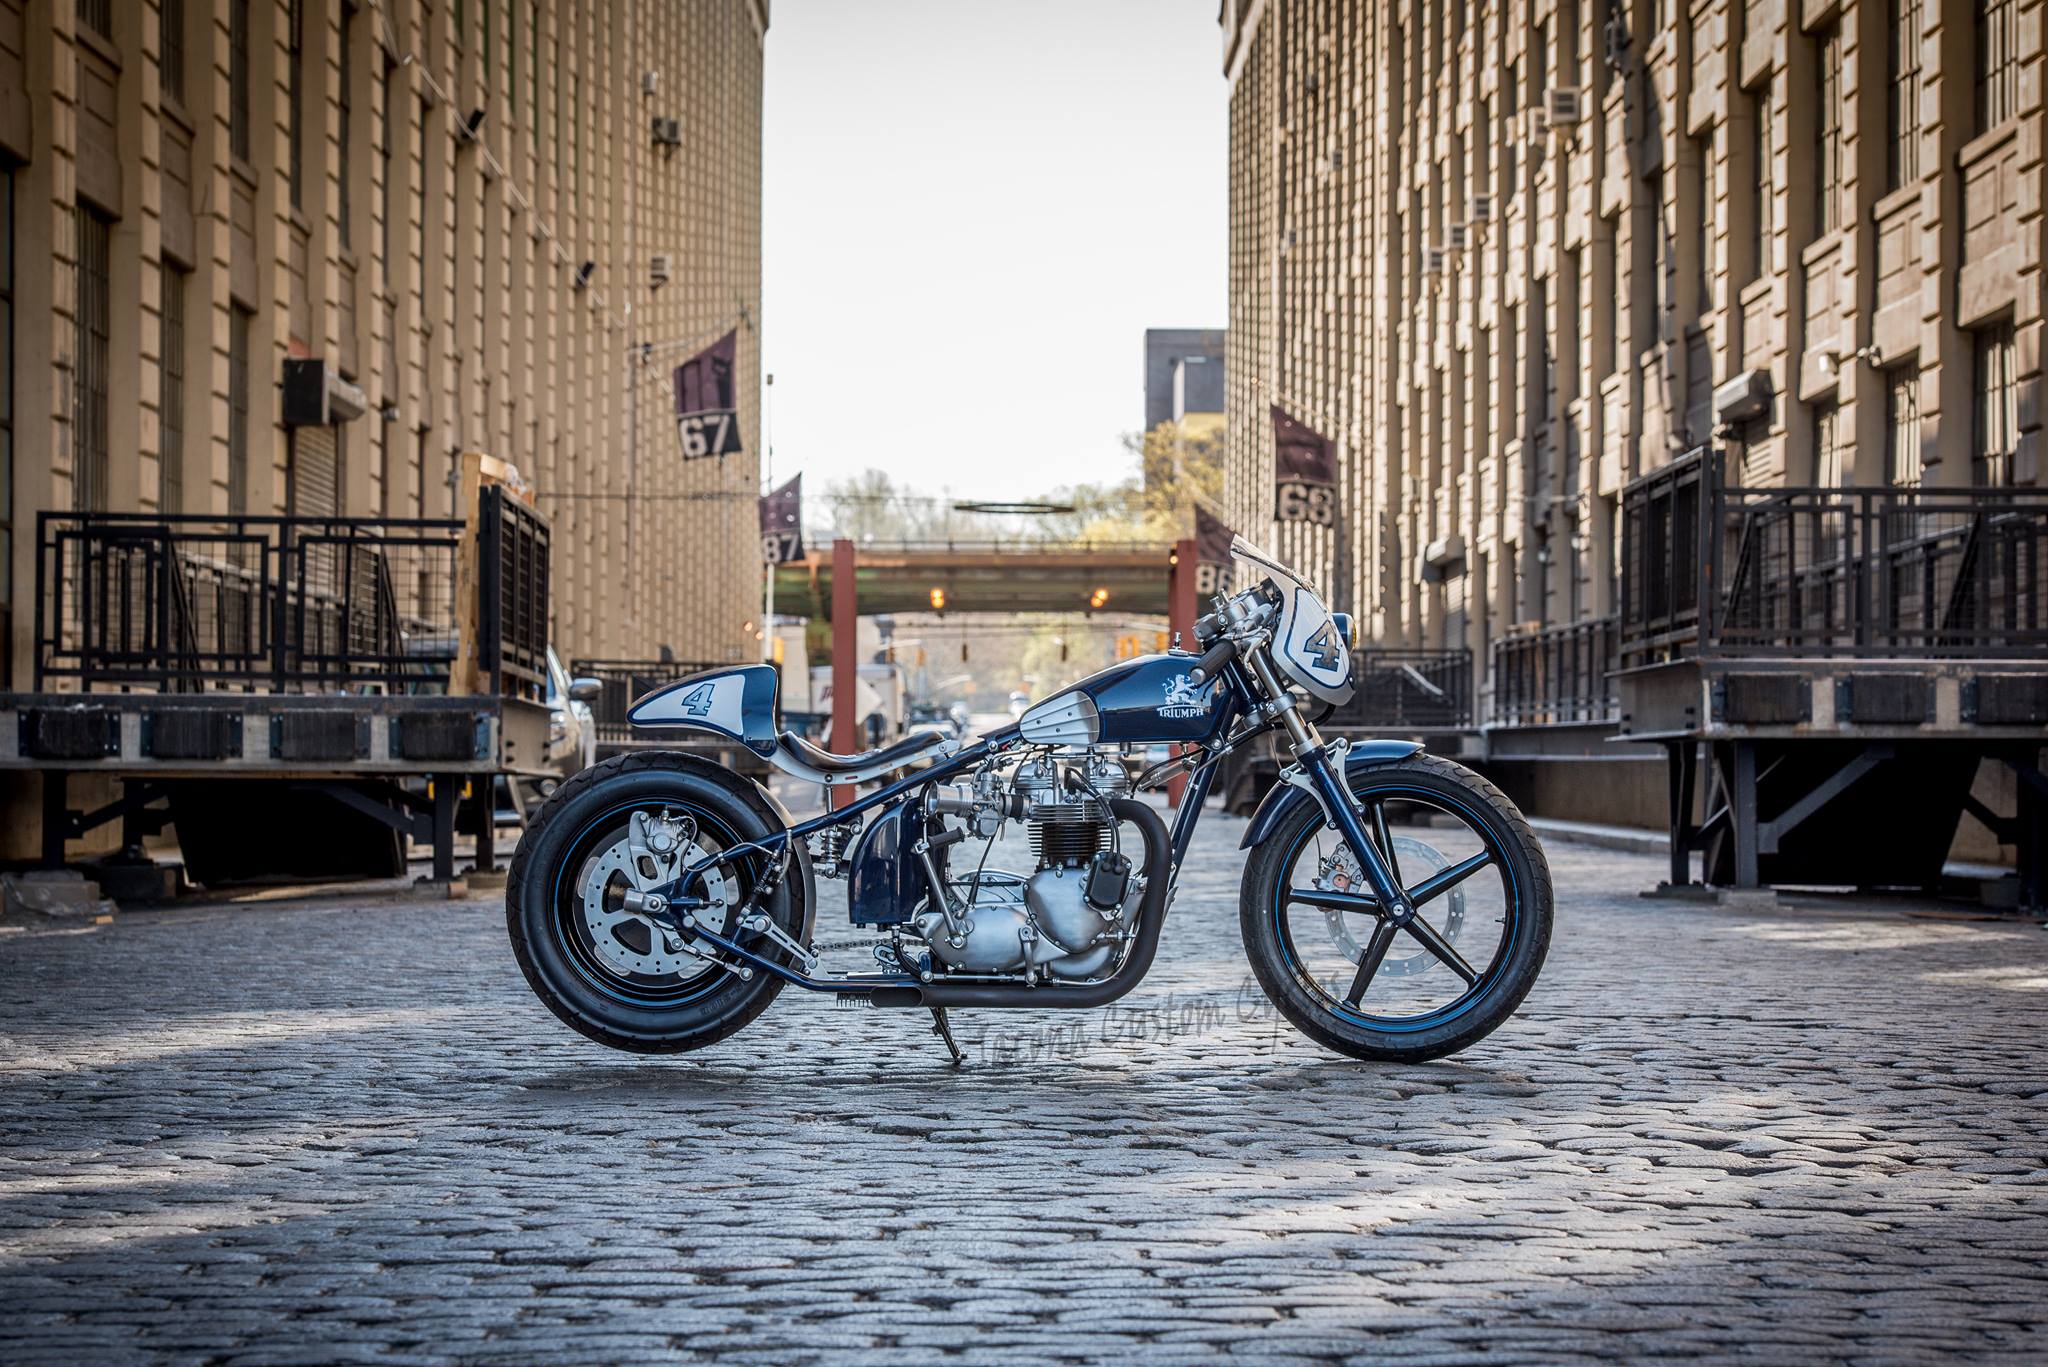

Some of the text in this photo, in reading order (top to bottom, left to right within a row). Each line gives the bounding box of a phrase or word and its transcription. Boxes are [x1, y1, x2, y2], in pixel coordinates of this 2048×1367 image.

[679, 414, 731, 458] 67
[1279, 483, 1335, 526] 68
[763, 533, 799, 564] 87
[1304, 619, 1341, 672] 4
[681, 683, 716, 716] 4
[1157, 704, 1204, 718] TRIUMPH
